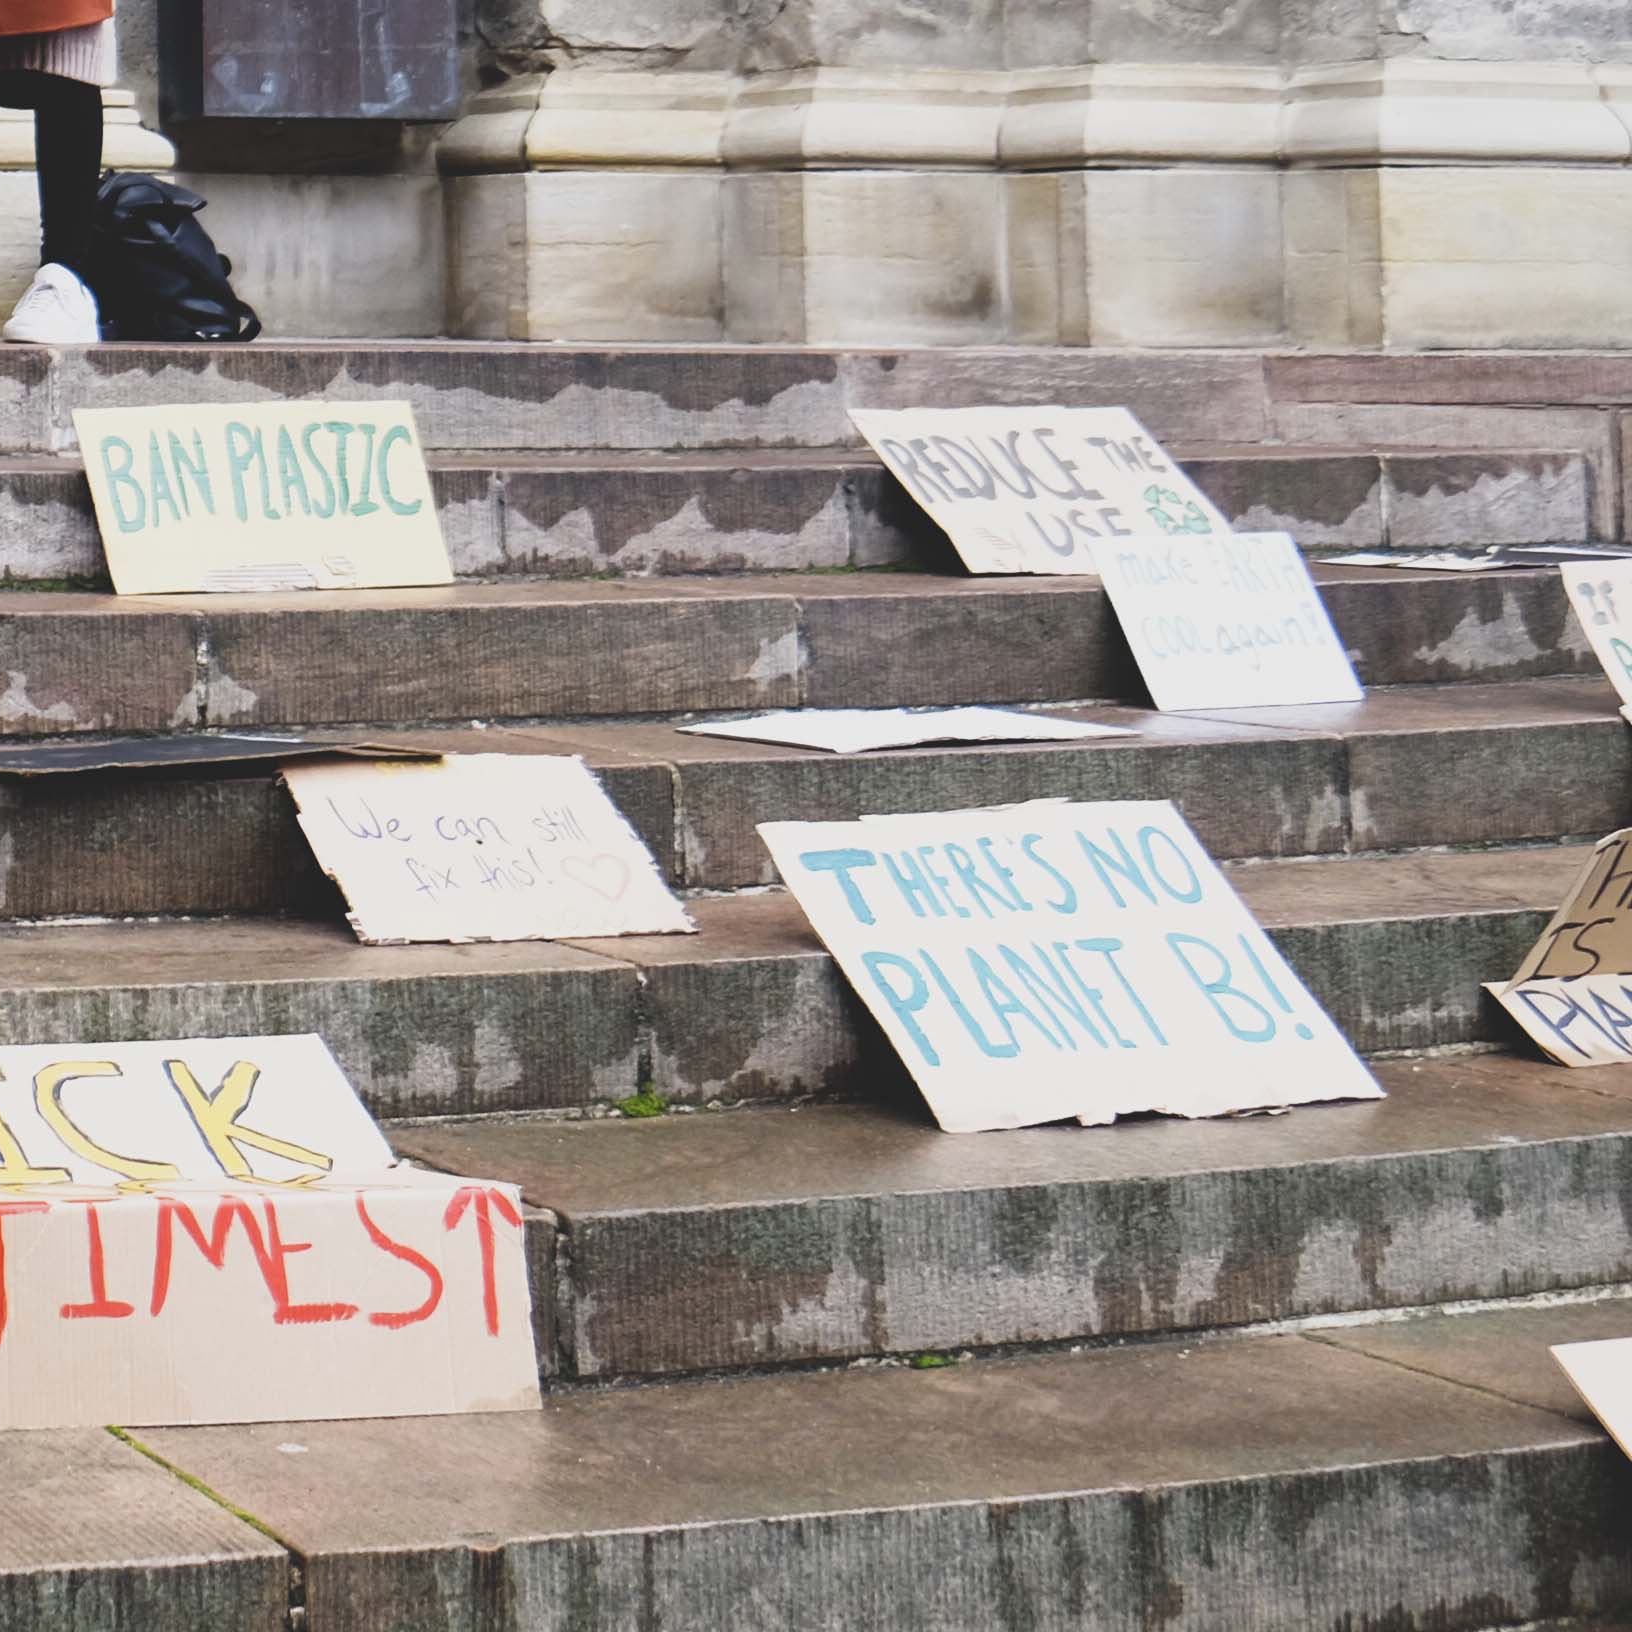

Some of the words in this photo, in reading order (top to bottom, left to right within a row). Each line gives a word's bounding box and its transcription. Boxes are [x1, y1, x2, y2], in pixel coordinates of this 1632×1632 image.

[99, 428, 216, 535] BAN
[225, 420, 423, 523] PLASTIC
[881, 428, 1104, 503] REDUCE
[1084, 436, 1166, 473] THE
[1026, 506, 1133, 557] USE
[326, 796, 412, 841] We
[435, 816, 512, 844] can
[532, 806, 589, 843] still
[405, 857, 460, 903] fix
[473, 847, 555, 889] this!
[1075, 825, 1203, 909] NO
[860, 937, 1169, 1068] PLANET
[1165, 932, 1315, 1044] B!
